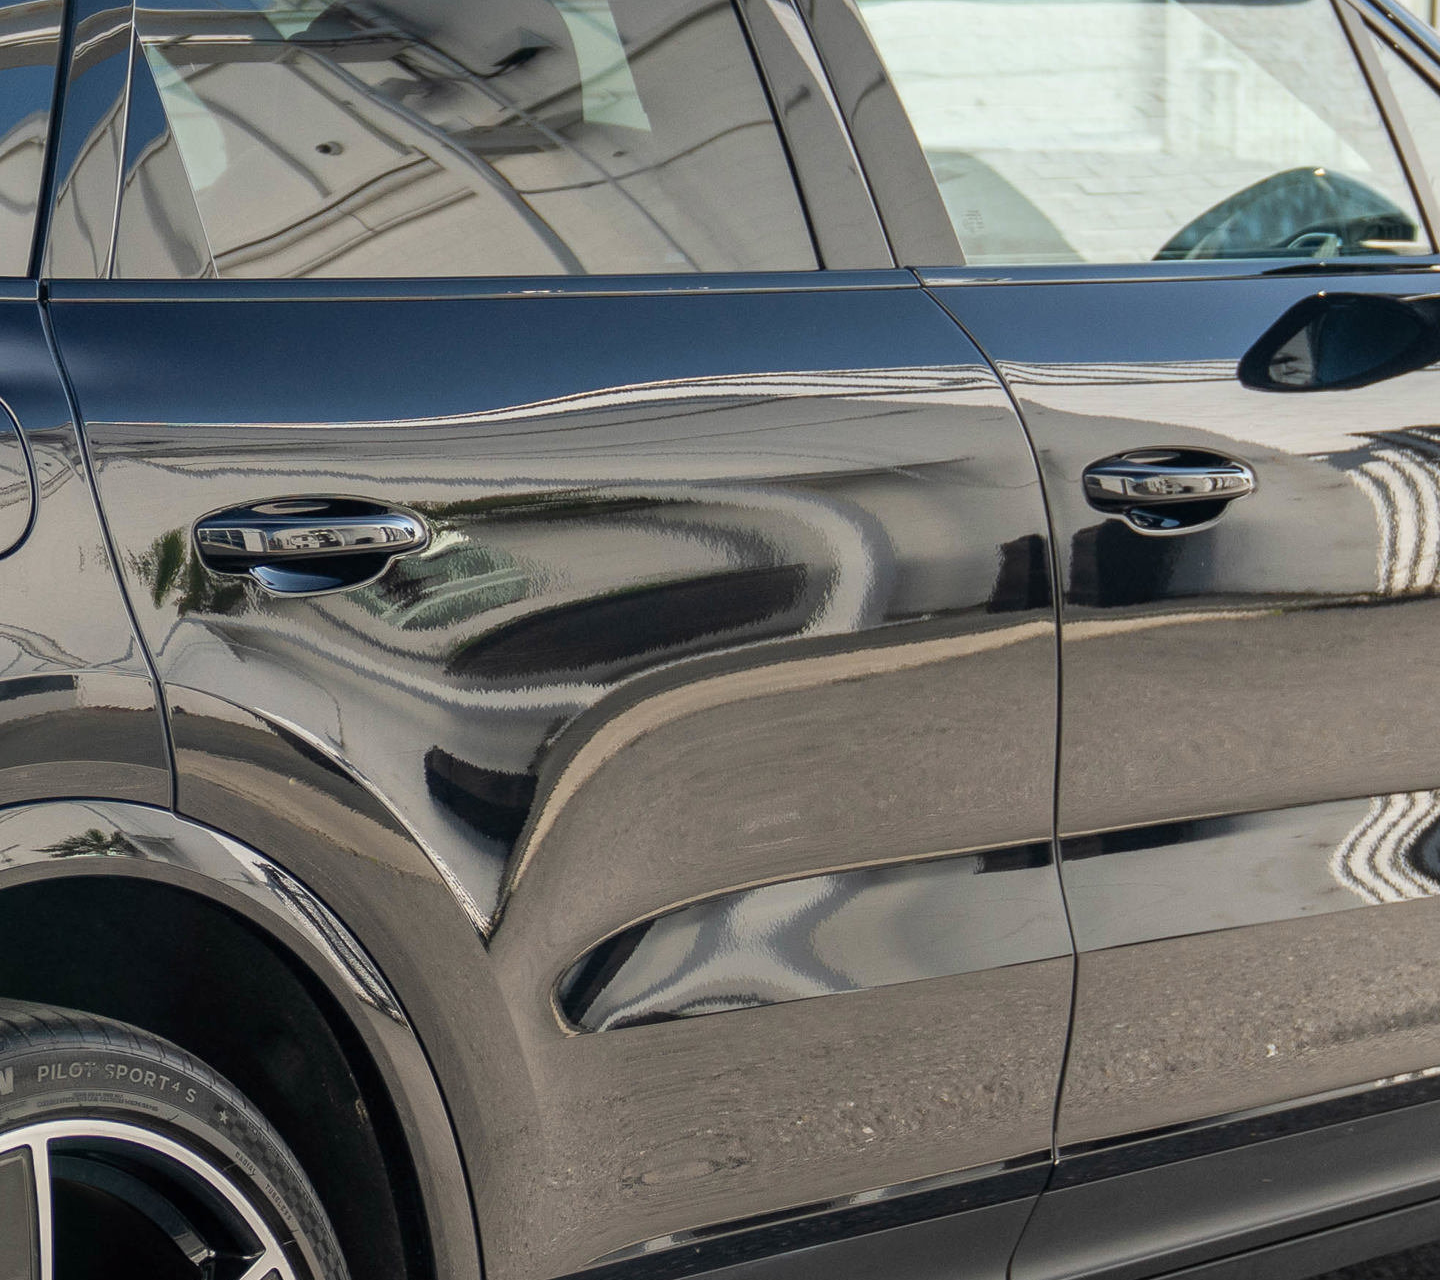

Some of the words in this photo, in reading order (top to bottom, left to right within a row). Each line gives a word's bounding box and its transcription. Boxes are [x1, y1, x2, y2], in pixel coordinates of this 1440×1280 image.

[37, 1062, 97, 1082] PILOT
[104, 1063, 170, 1091] SPORT
[184, 1088, 197, 1103] S
